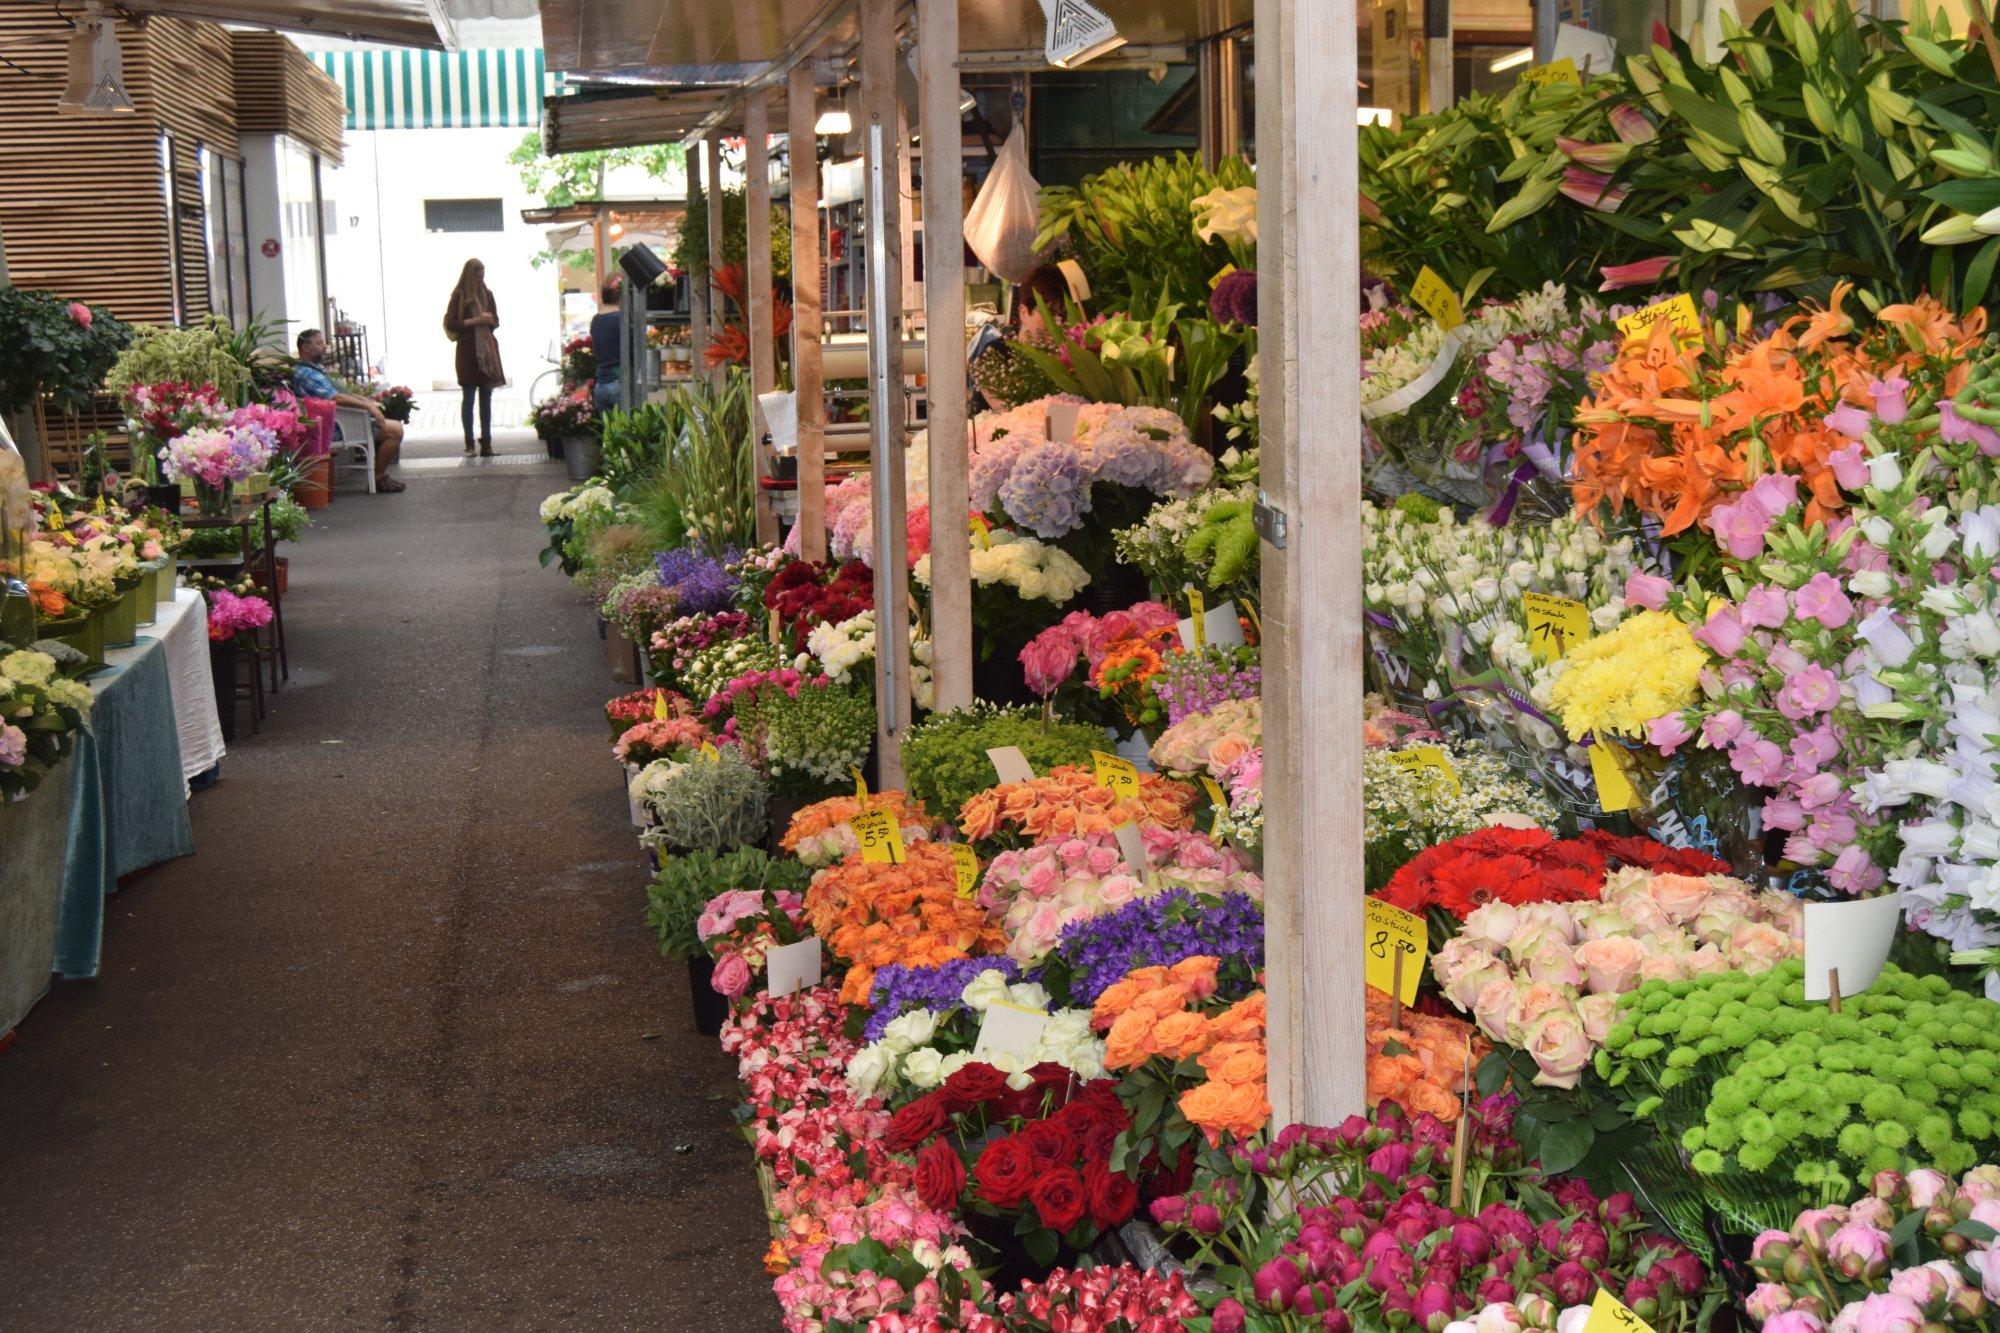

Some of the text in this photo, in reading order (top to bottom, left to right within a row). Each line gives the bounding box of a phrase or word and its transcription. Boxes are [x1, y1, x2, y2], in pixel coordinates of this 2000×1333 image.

[856, 823, 866, 831] 10
[1366, 912, 1382, 923] 10
[1370, 931, 1417, 959] 8.50
